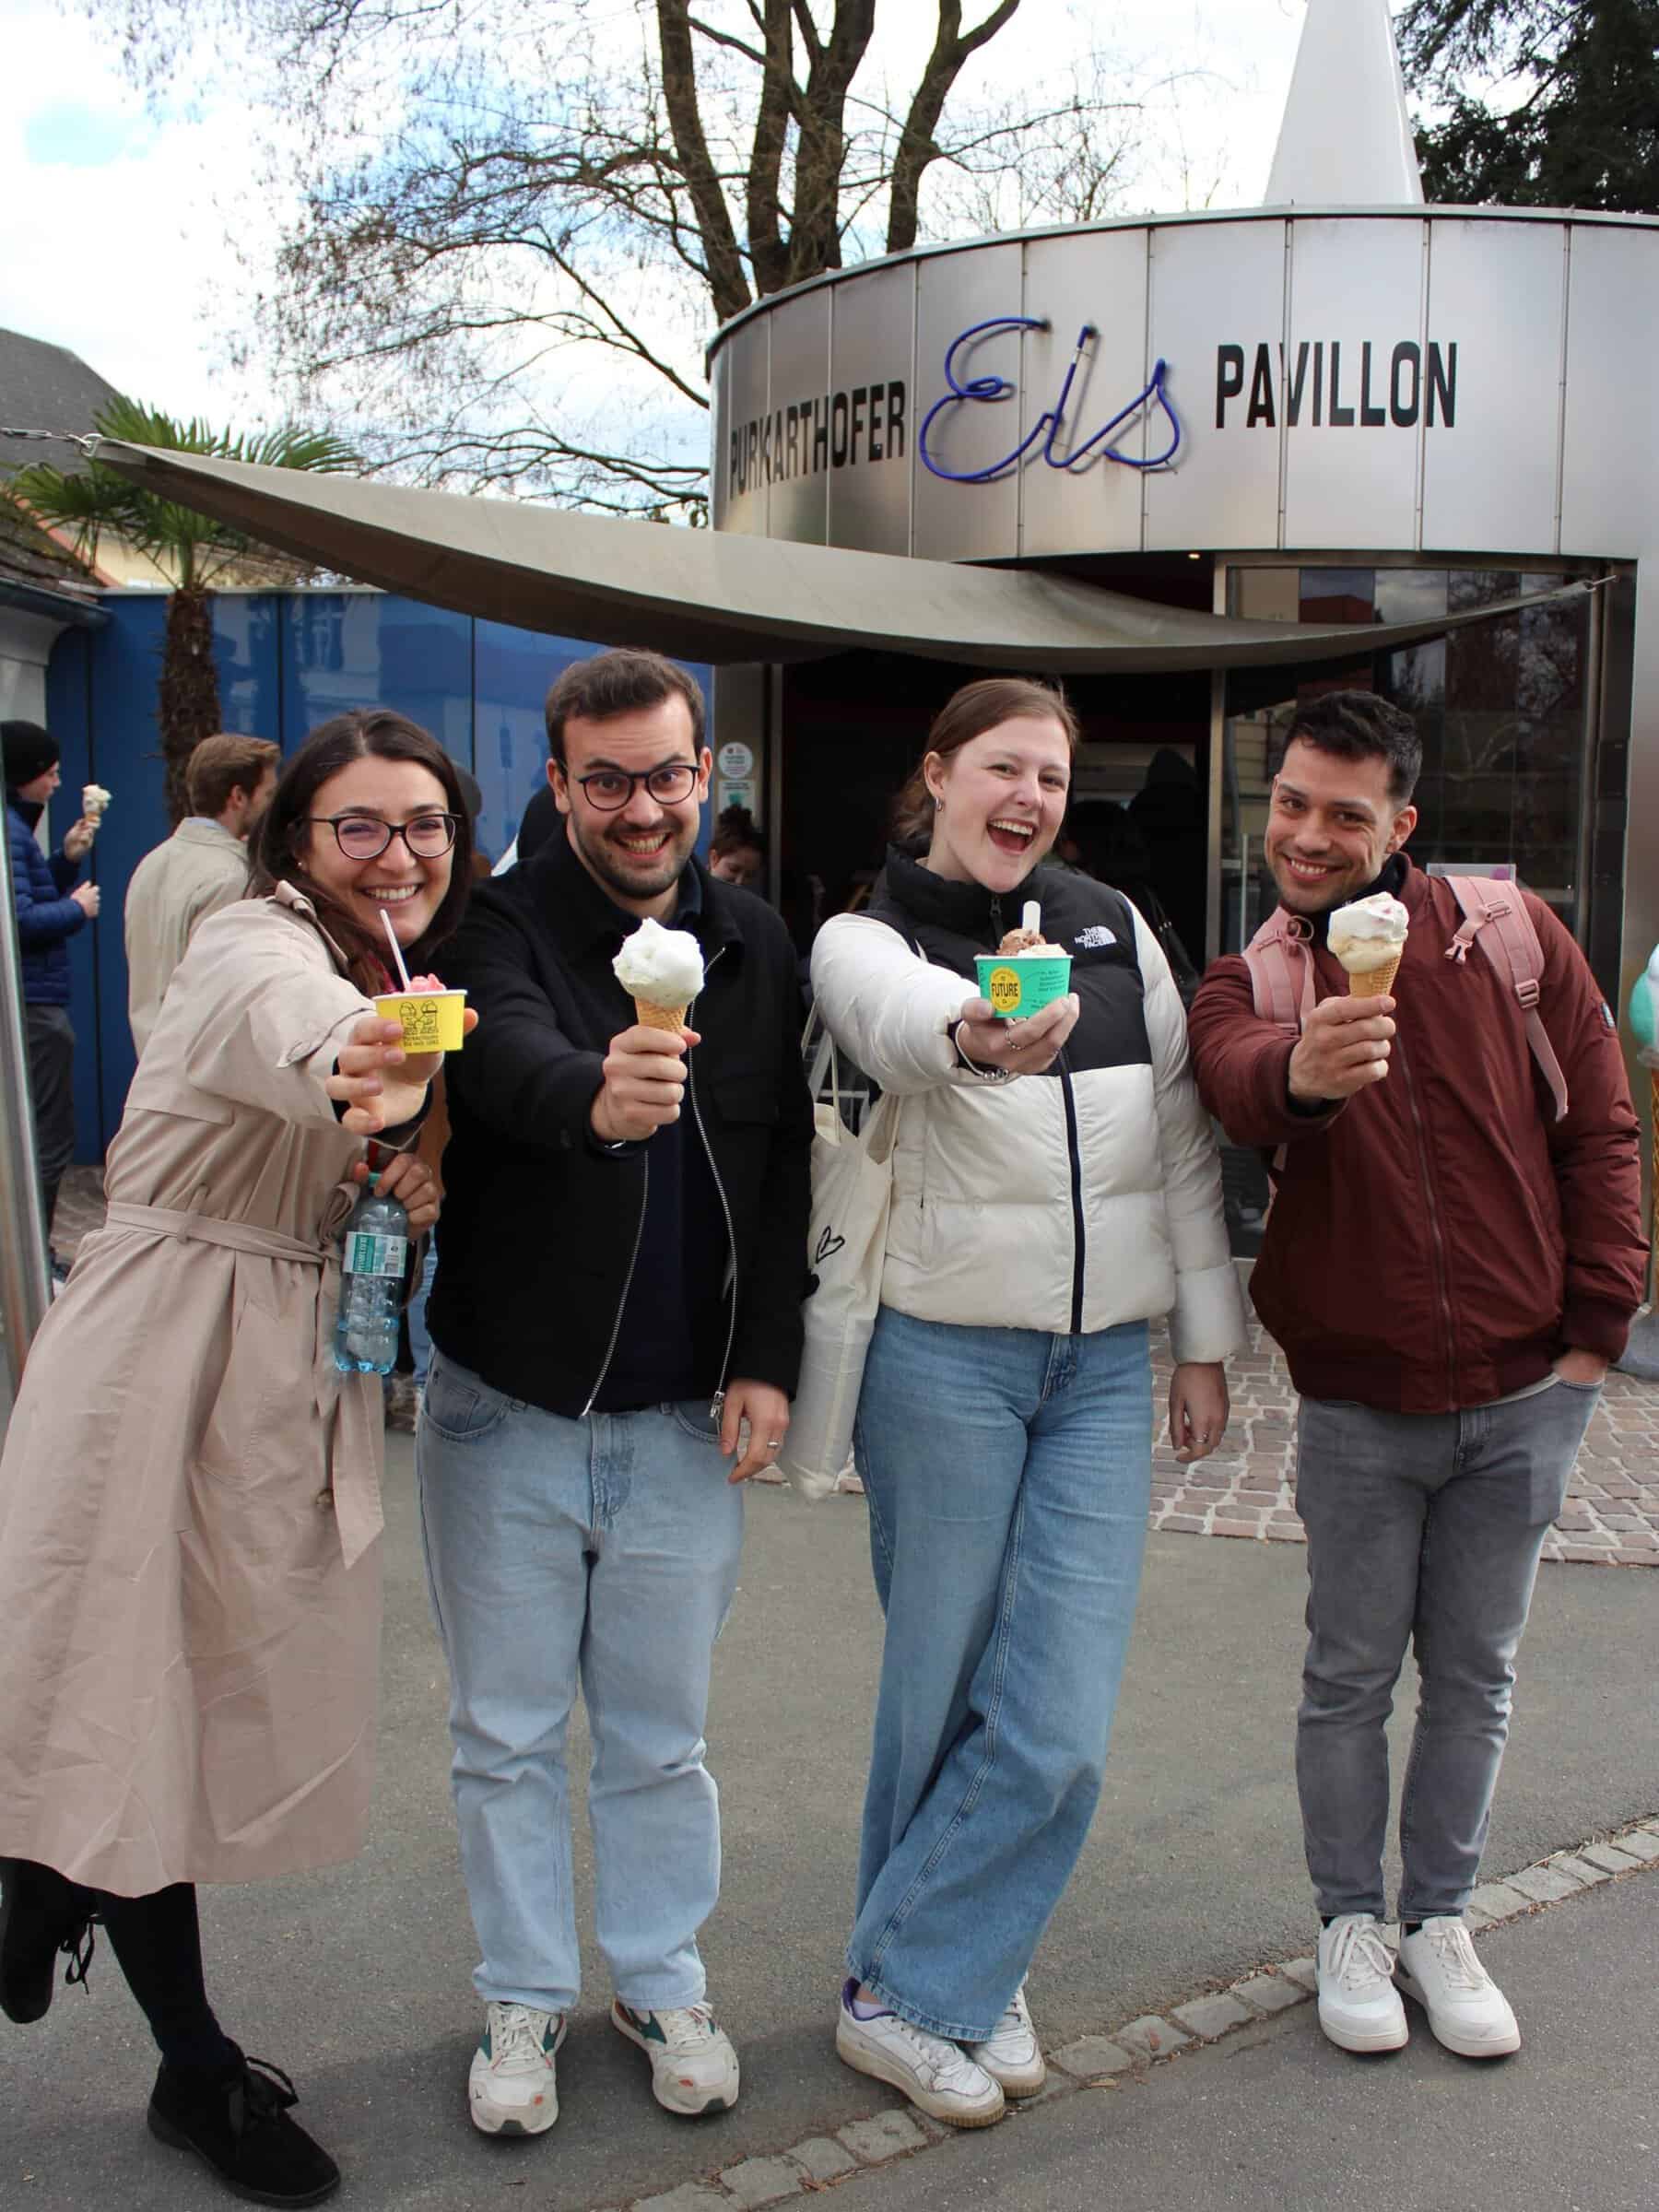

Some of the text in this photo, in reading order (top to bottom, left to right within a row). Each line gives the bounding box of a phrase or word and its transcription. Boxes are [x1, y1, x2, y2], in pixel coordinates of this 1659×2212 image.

[730, 317, 1457, 501] PURKARTHOFER Eis PAVILLON
[991, 982, 1018, 997] FUTURE
